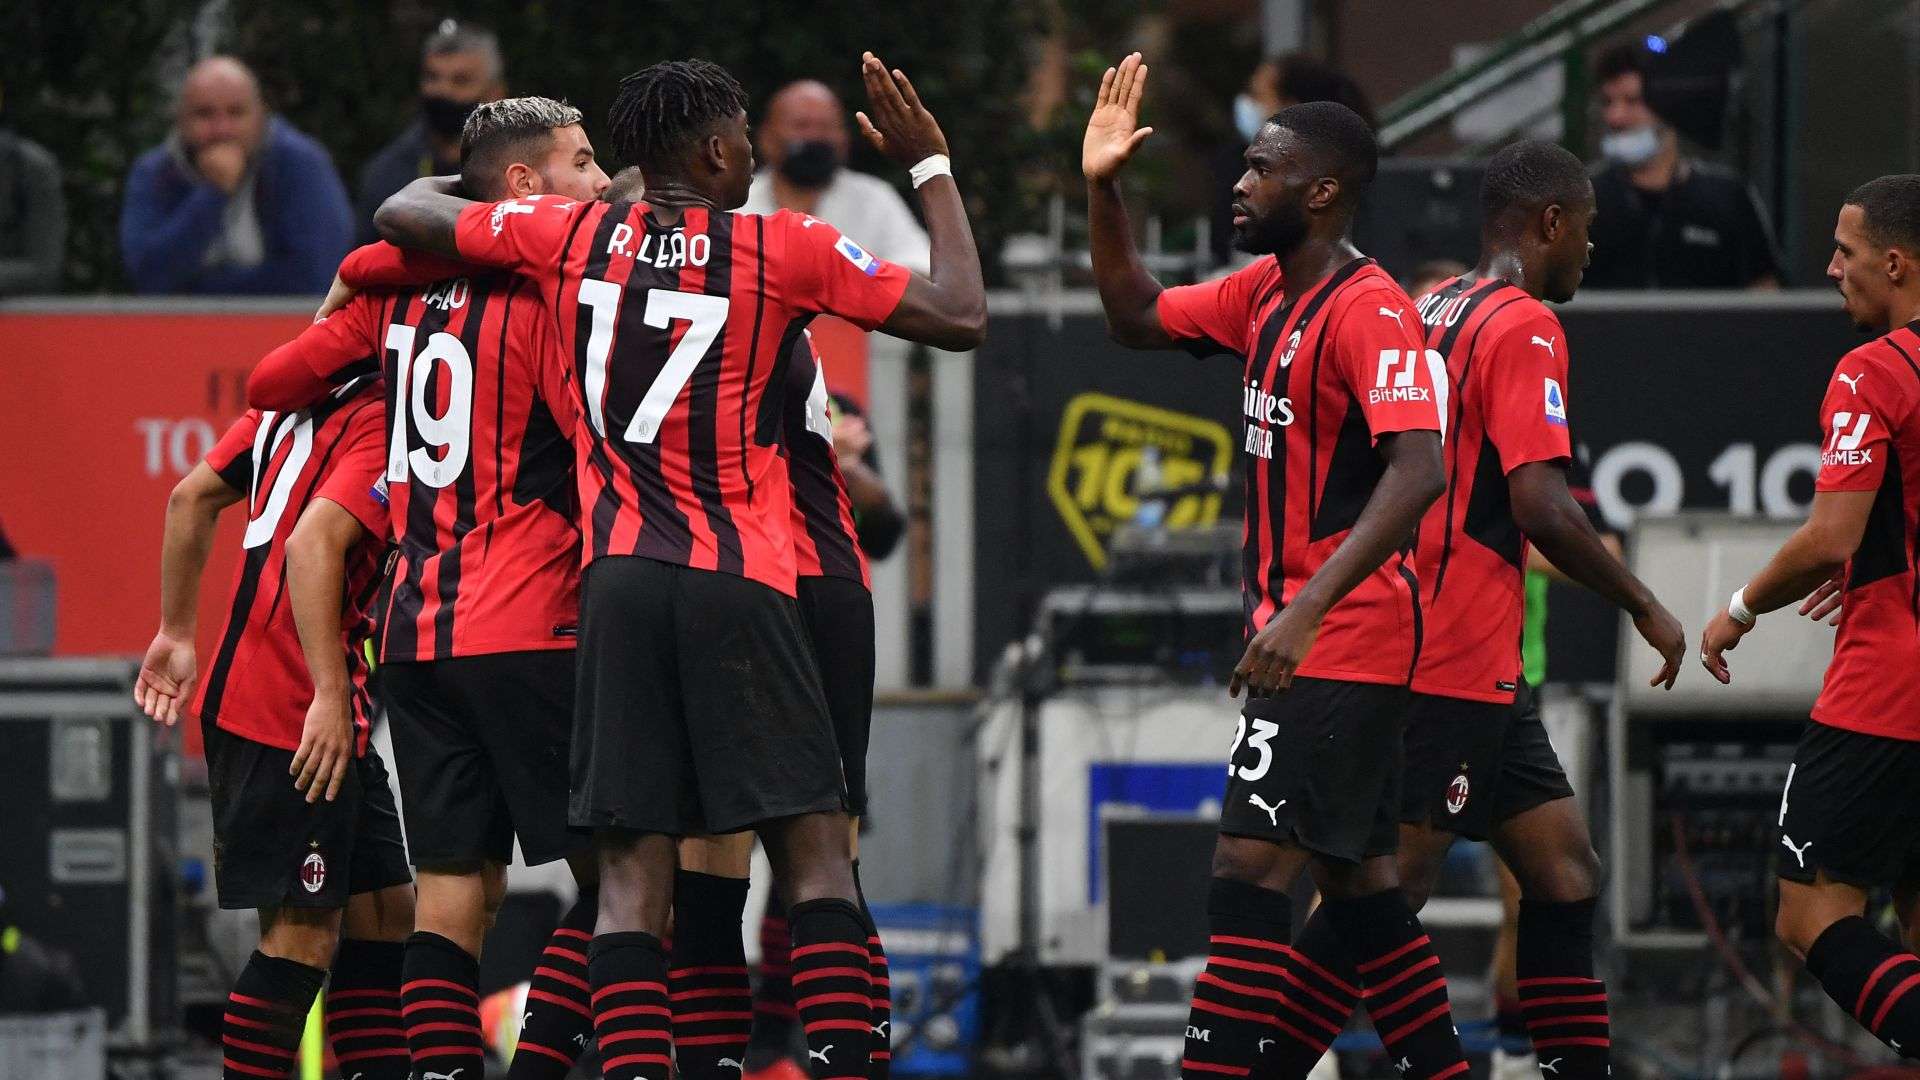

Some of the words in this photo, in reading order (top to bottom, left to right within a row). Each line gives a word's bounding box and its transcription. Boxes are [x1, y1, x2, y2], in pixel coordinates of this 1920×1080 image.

[577, 278, 730, 444] 17
[385, 323, 473, 489] 19
[1368, 387, 1431, 404] BitMEX
[1821, 449, 1872, 466] BitMEX
[1228, 714, 1279, 781] 23
